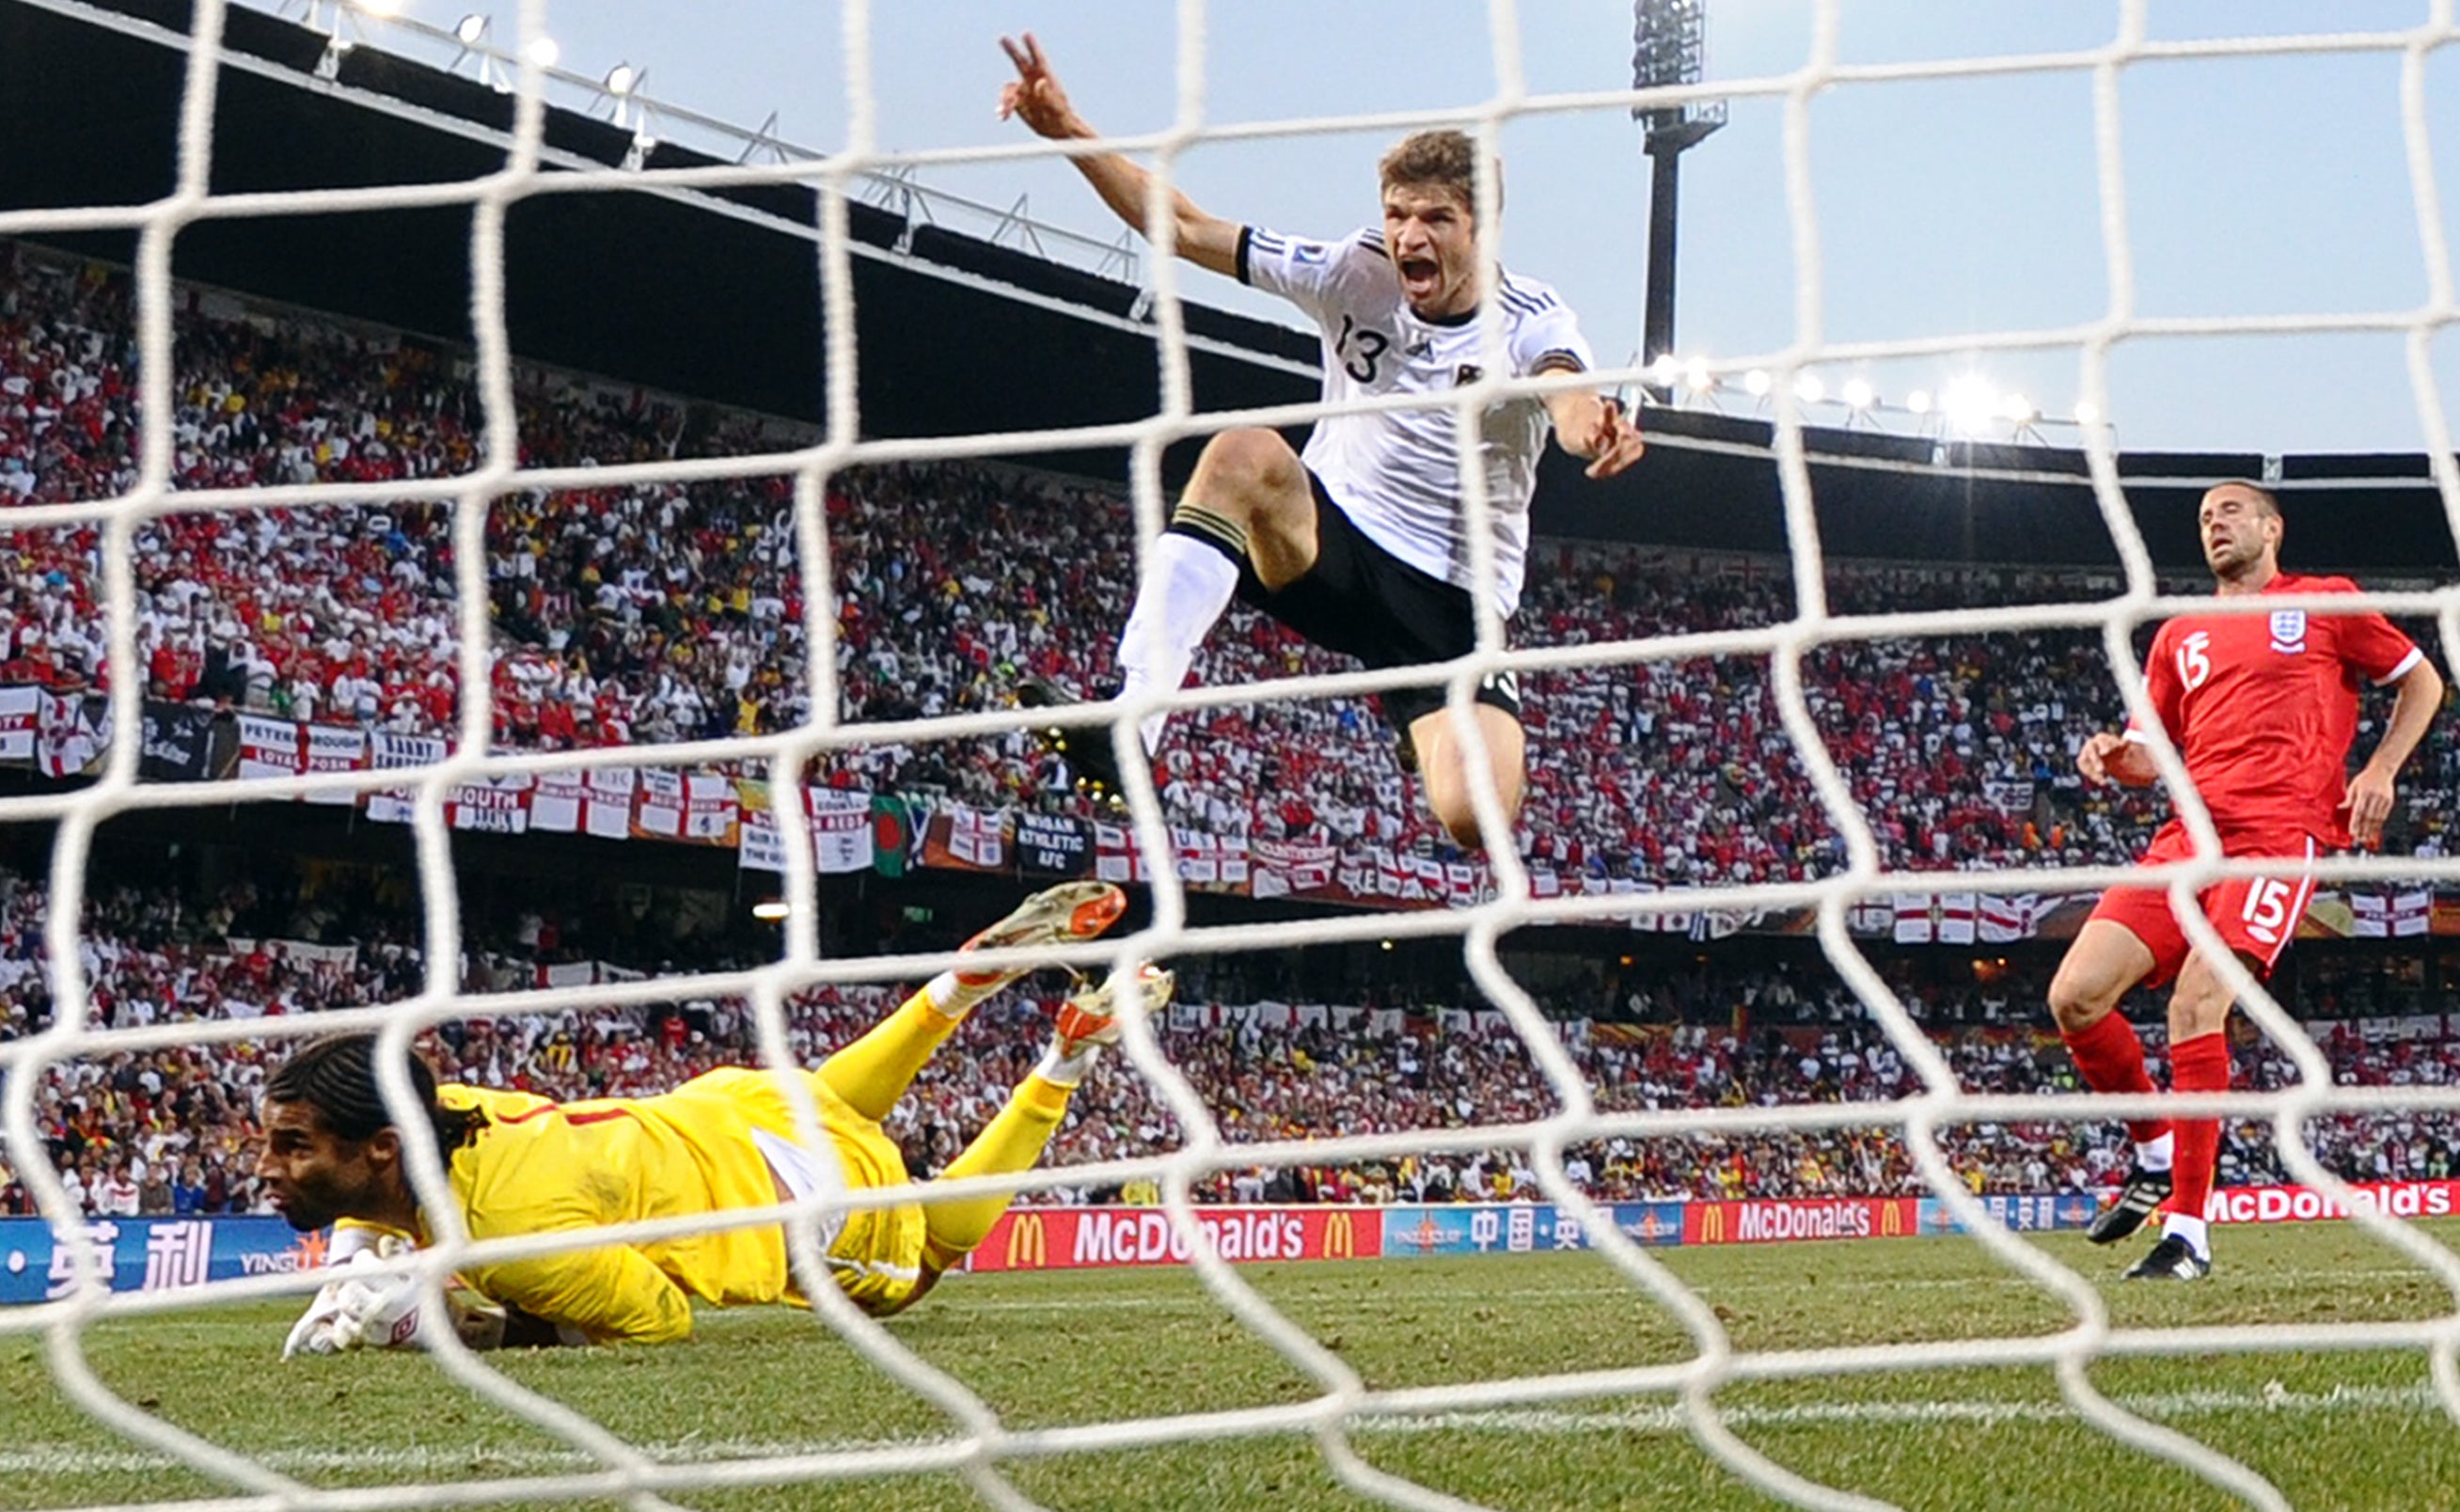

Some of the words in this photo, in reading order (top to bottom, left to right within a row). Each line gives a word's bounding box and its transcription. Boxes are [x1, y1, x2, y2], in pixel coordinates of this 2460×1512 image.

[1334, 313, 1389, 384] 13
[2175, 632, 2210, 693] 15
[1017, 827, 1085, 853] ATHLETIC
[2242, 875, 2290, 929] 15
[1072, 1213, 1305, 1263] McDonald's
[1737, 1201, 1871, 1241] McDonald's
